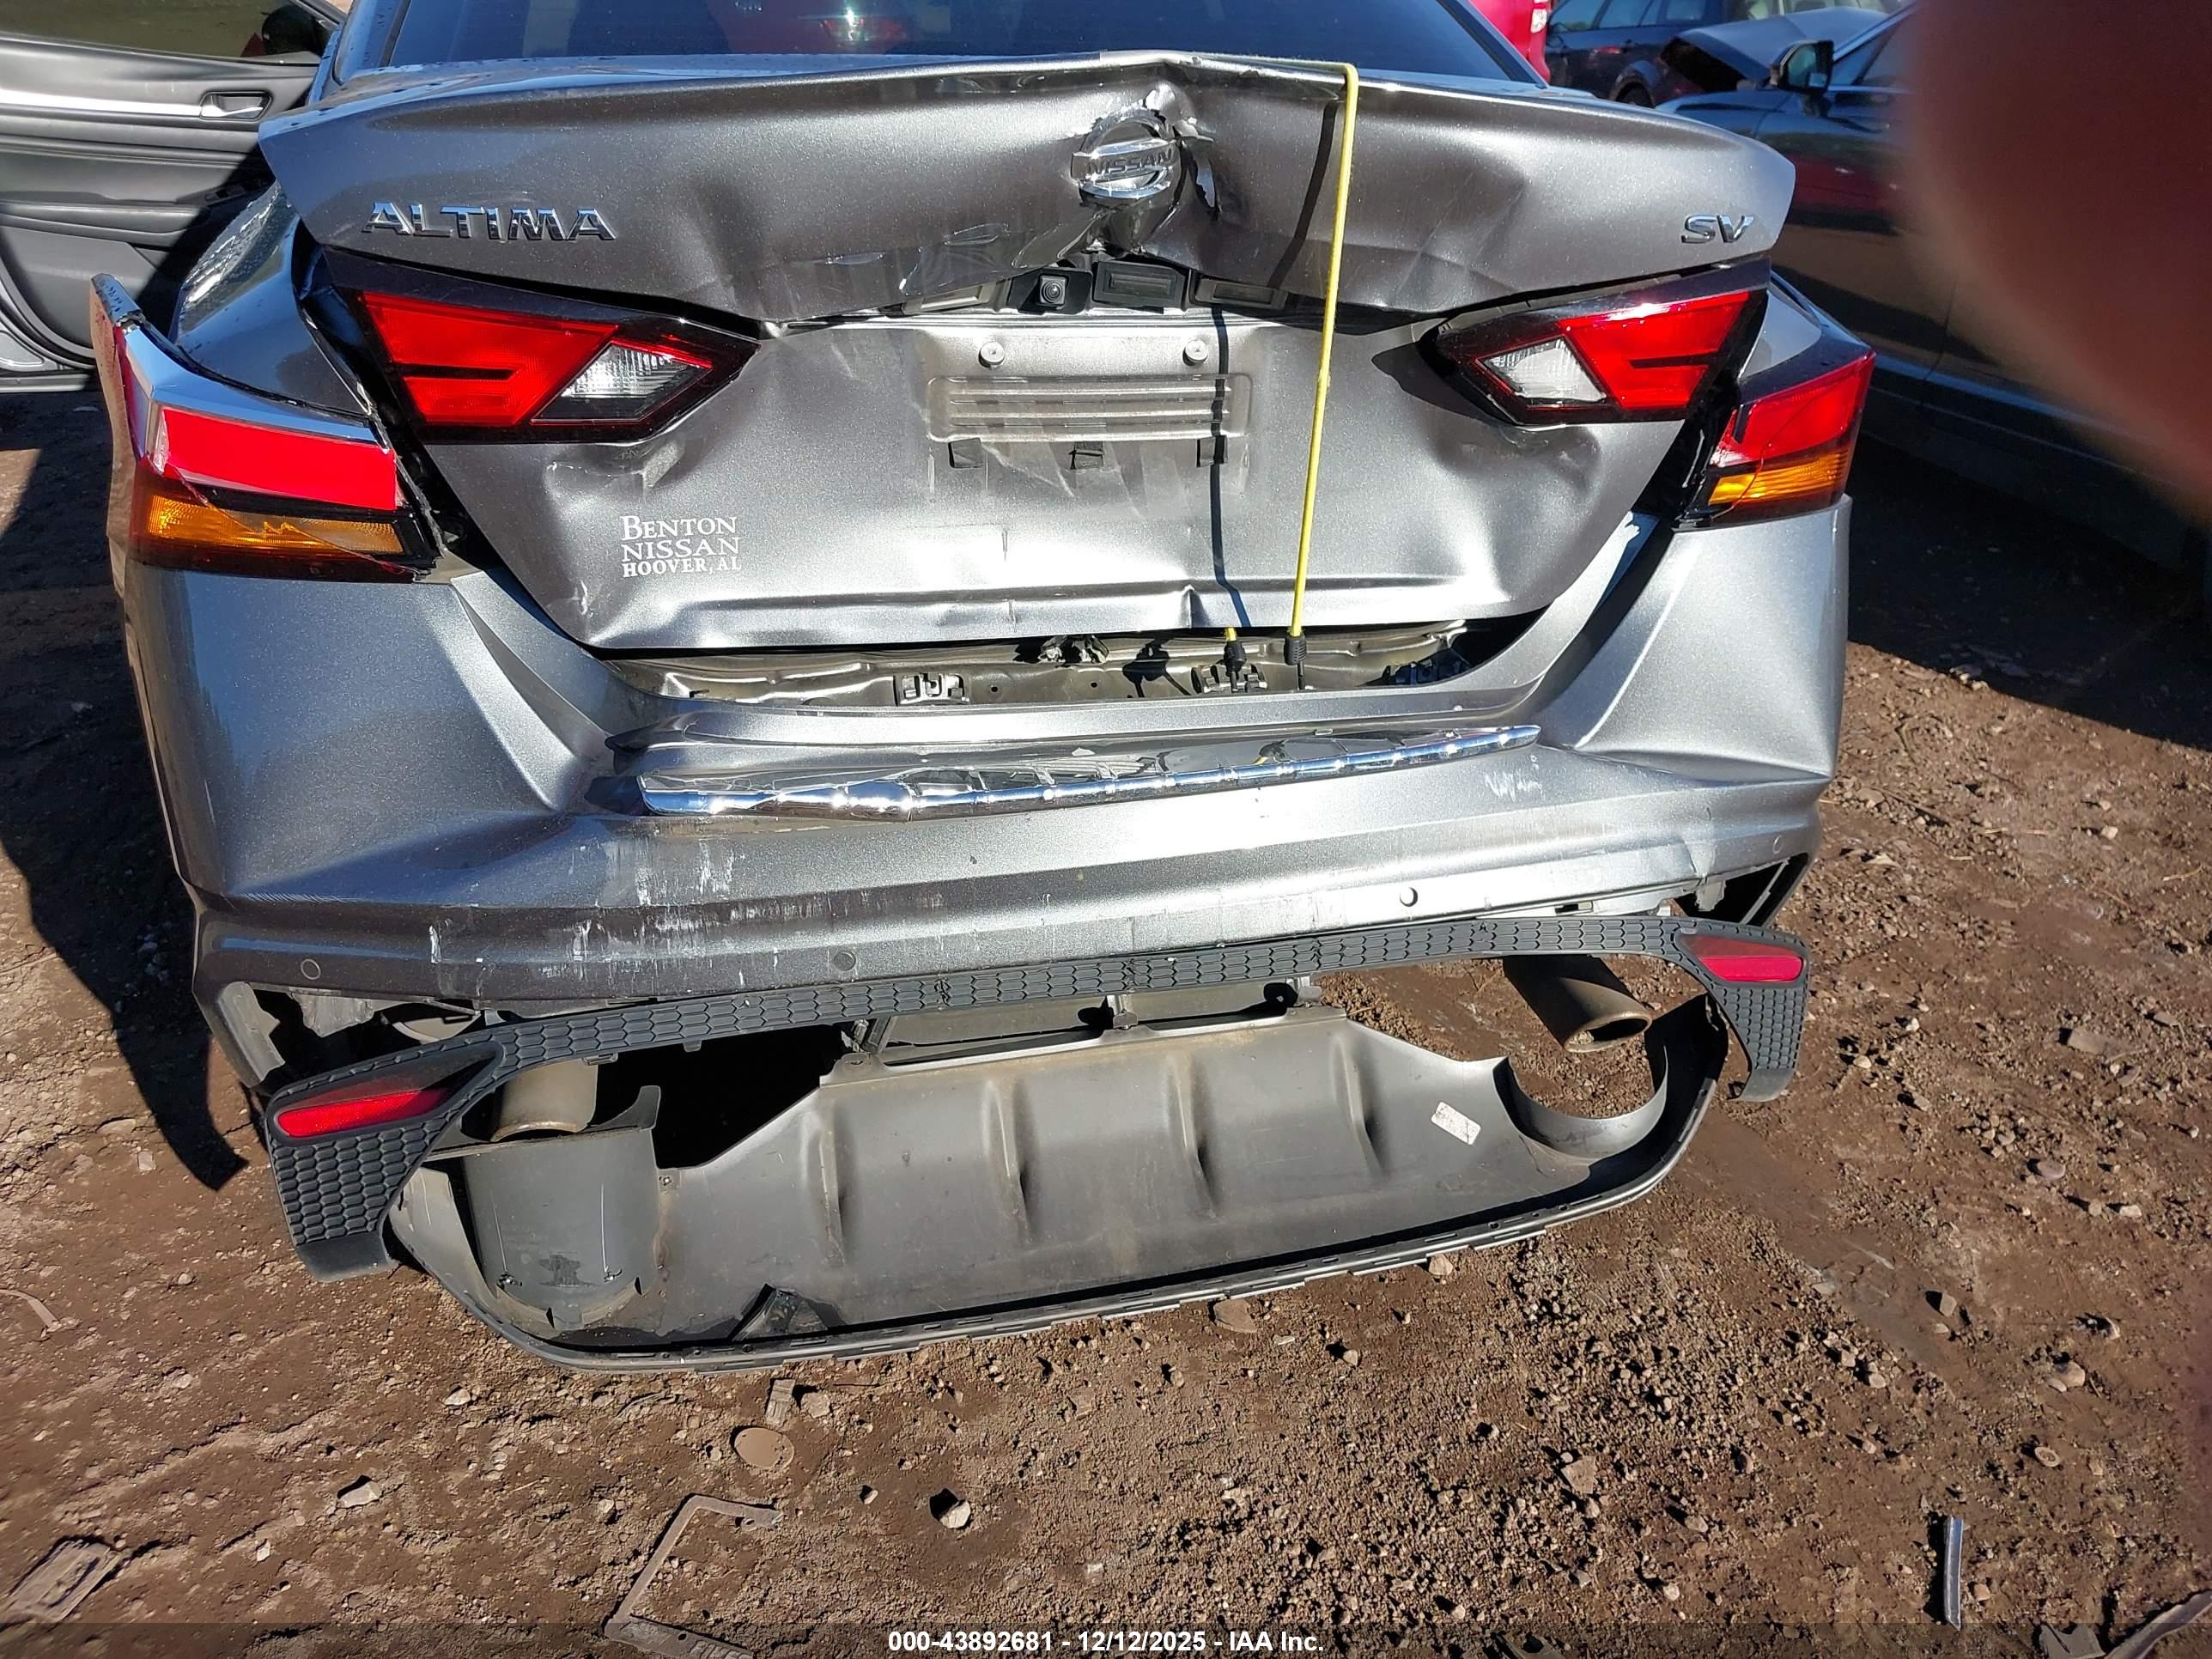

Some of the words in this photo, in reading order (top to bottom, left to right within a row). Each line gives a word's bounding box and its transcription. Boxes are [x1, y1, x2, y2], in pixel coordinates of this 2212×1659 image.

[1087, 148, 1173, 175] NISSAN
[362, 201, 617, 240] ALTIMA
[1680, 215, 1754, 243] SV
[620, 515, 737, 540] BENTON
[621, 537, 740, 562] NISSAN
[622, 558, 714, 578] HOOVER,
[716, 556, 742, 571] AL
